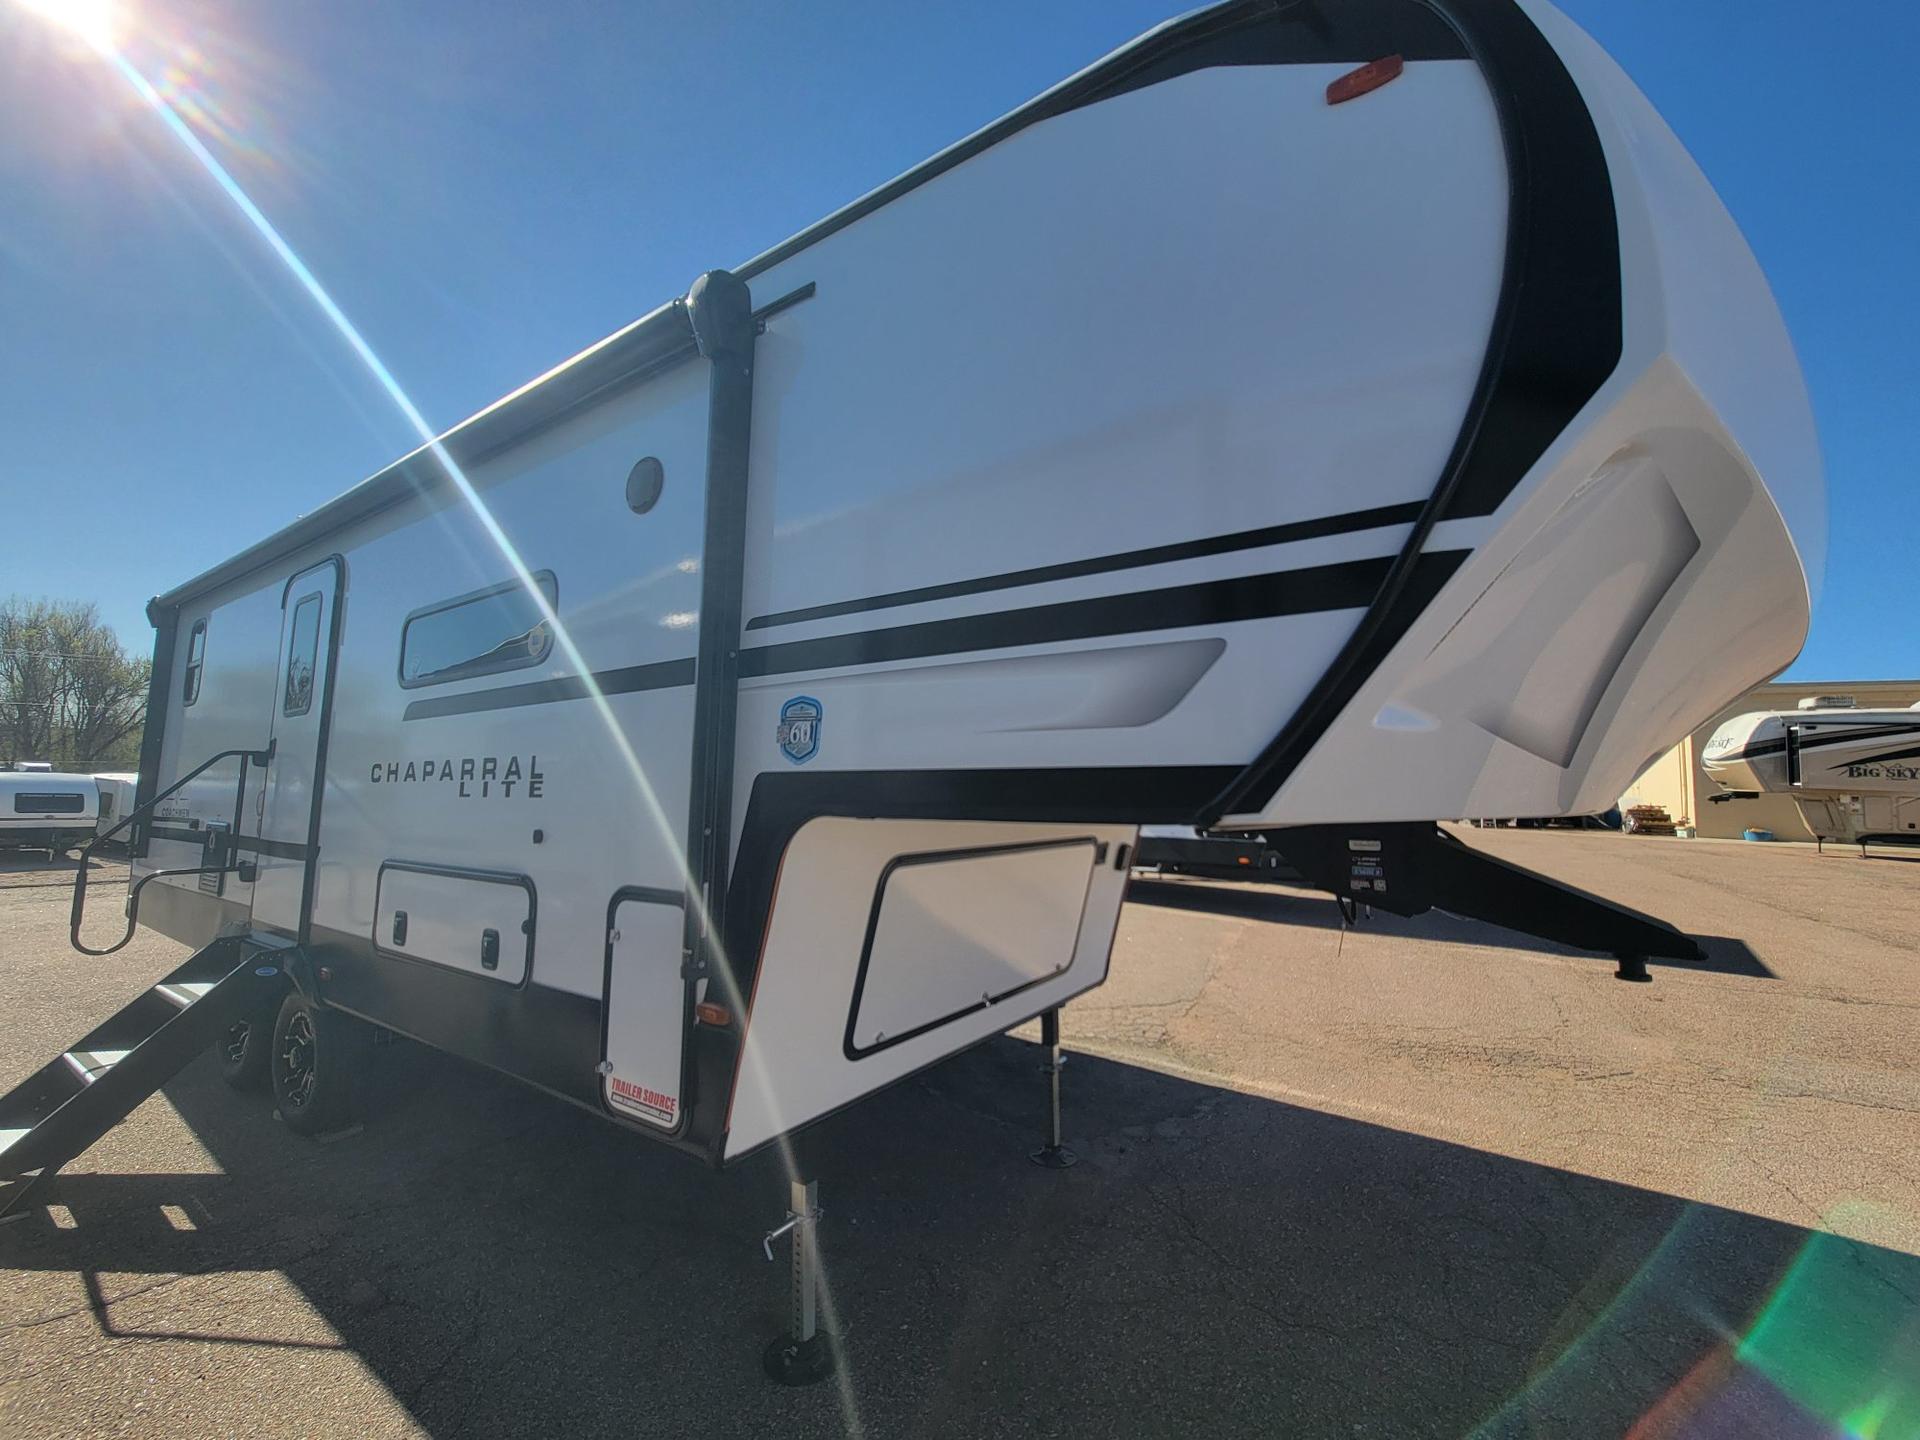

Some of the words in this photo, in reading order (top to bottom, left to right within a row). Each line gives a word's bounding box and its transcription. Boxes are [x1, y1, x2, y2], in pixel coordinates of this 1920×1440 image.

[371, 755, 544, 783] CHAPARRAL
[1848, 766, 1880, 778] BIG
[1886, 767, 1919, 779] SKY
[459, 780, 544, 798] LITE
[612, 1077, 642, 1100] TRAILER
[643, 1089, 677, 1112] SOURCE
